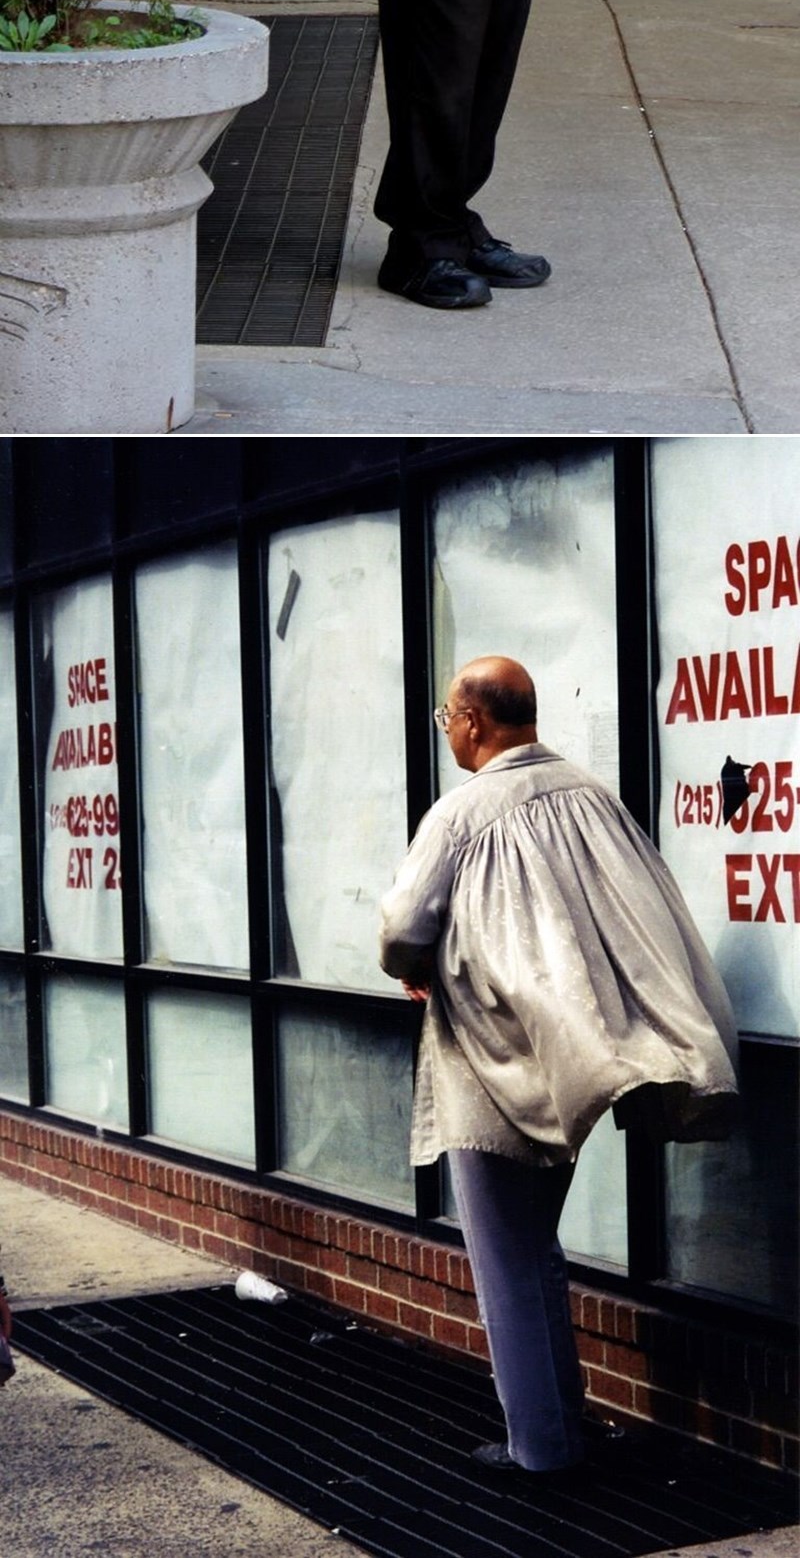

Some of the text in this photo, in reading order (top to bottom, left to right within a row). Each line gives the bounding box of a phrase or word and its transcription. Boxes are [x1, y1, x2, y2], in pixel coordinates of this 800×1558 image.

[725, 536, 800, 616] SPA
[68, 658, 109, 708] SPACE
[665, 642, 800, 725] AVAIL
[53, 722, 118, 771] AVAILAB
[674, 780, 722, 829] (215)
[67, 847, 122, 890] EXT 2
